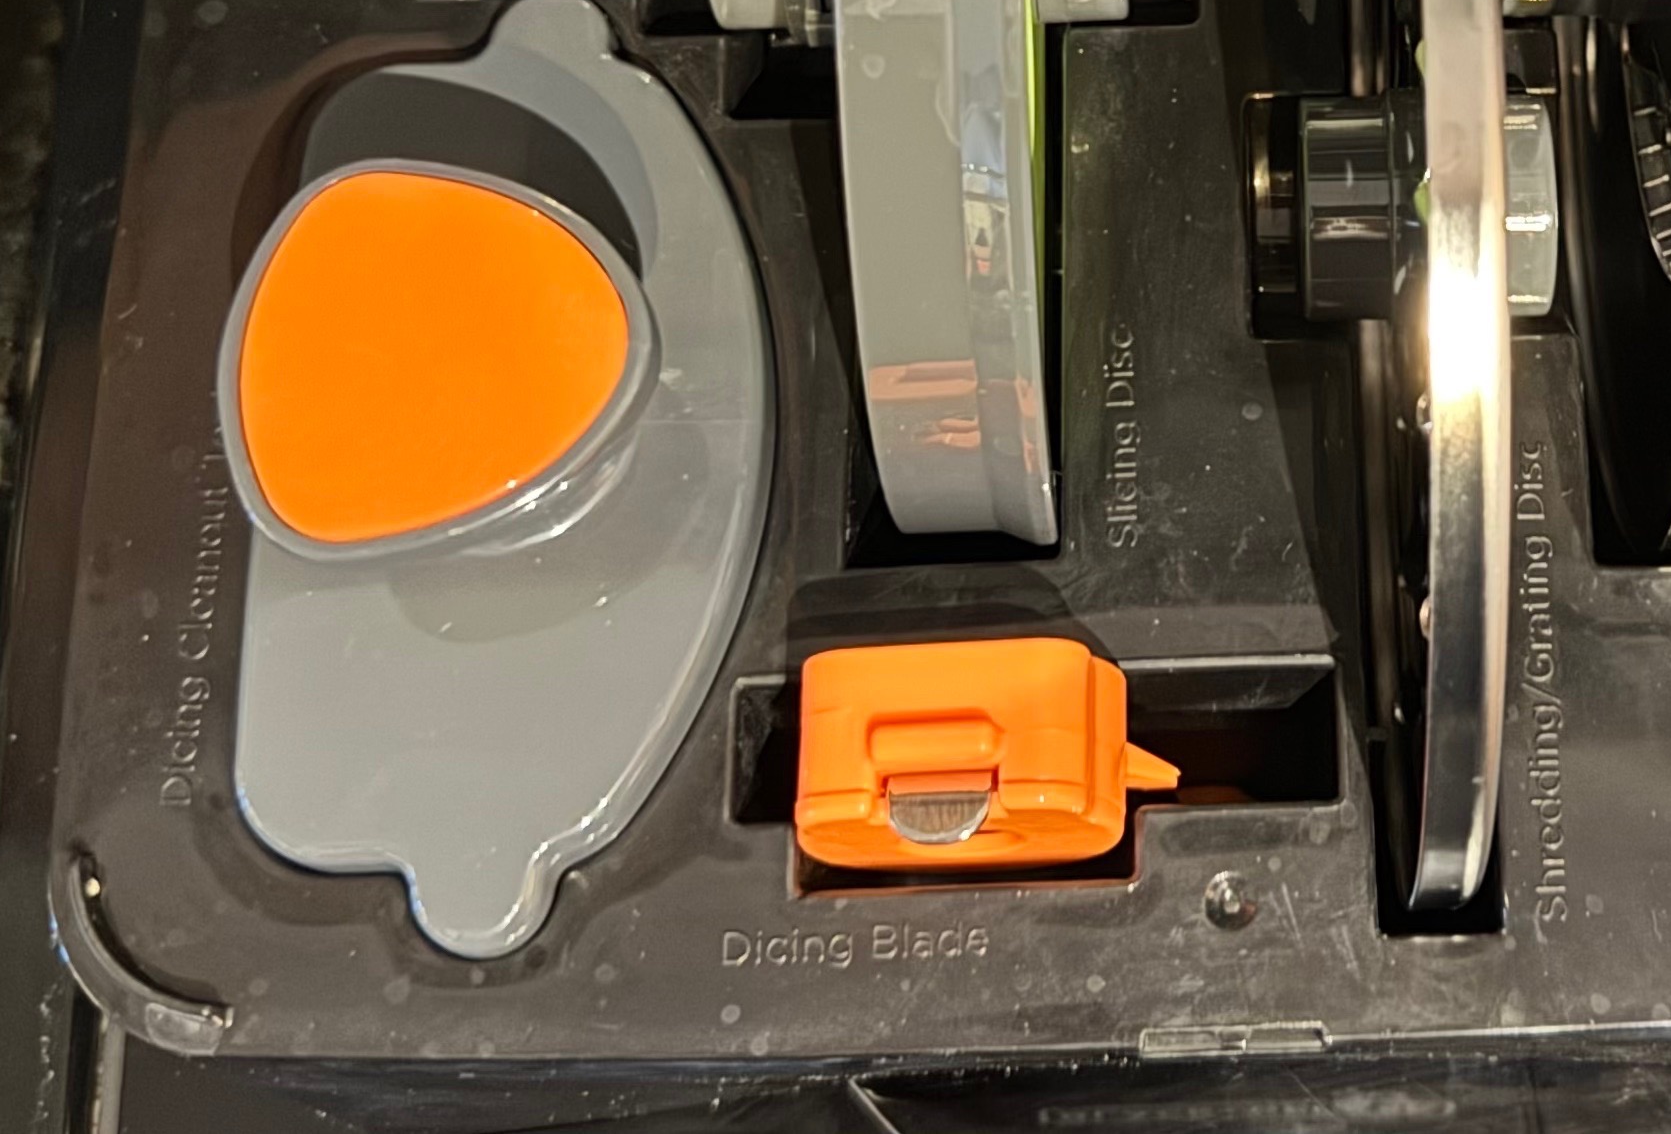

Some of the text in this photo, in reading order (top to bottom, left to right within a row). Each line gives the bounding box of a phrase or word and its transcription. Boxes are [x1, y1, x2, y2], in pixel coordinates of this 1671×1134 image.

[1103, 322, 1141, 549] Slicing Disc
[176, 484, 229, 662] Cleanout
[158, 675, 211, 808] Dicing
[1513, 440, 1570, 924] Shredding/Grating Disc
[720, 919, 991, 970] Dicing Blade
